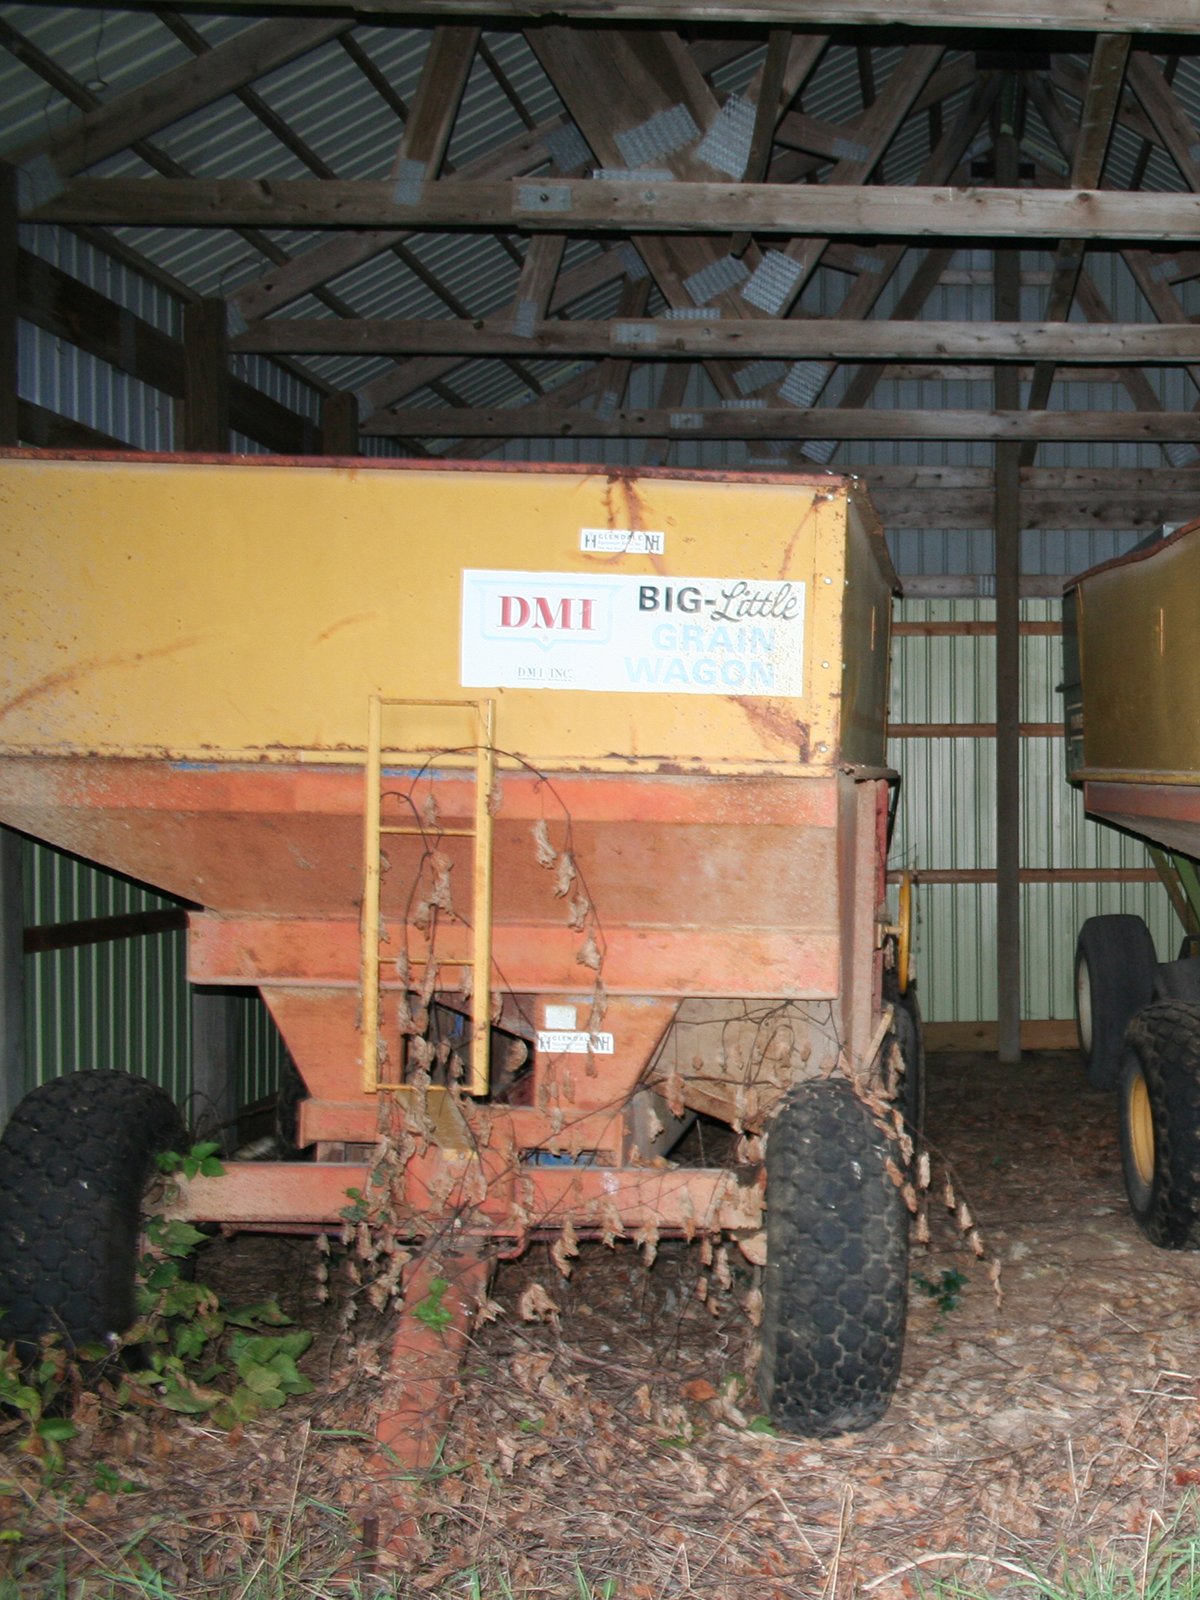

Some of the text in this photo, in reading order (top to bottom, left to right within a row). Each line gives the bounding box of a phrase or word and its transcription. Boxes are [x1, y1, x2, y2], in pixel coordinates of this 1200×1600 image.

[497, 595, 598, 631] DMI
[638, 581, 799, 622] BIG-Little
[651, 623, 776, 655] GRAIN
[623, 656, 776, 689] WAGON
